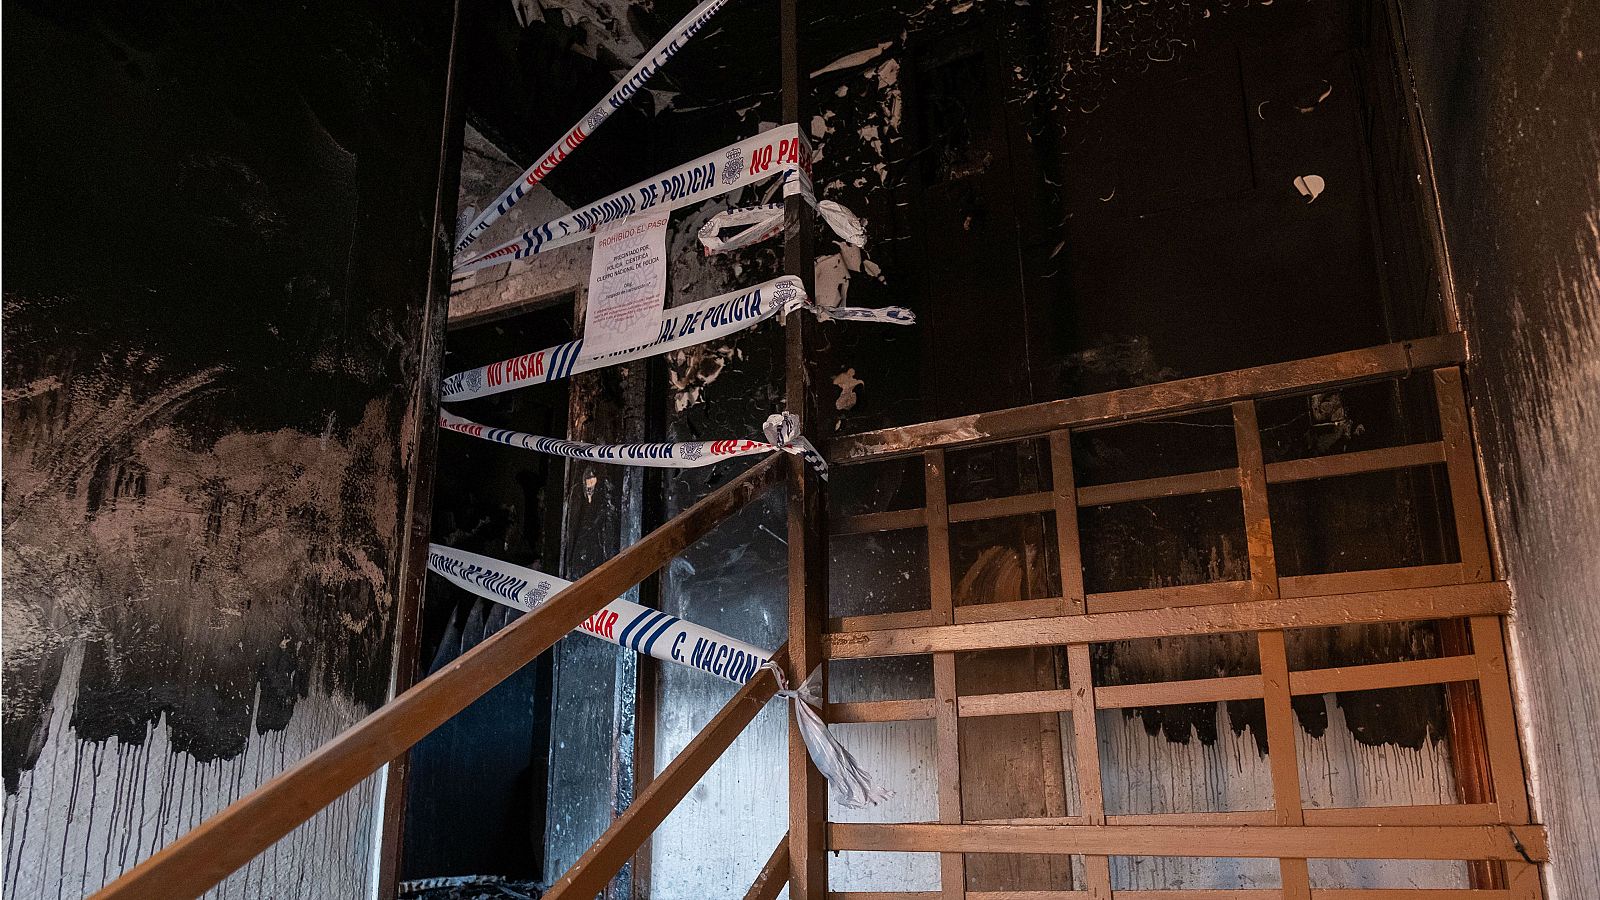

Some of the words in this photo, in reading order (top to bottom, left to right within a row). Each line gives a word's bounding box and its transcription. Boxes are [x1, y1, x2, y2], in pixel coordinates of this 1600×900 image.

[572, 193, 636, 233] NACIONAL
[640, 184, 659, 211] DE
[661, 162, 716, 203] POLICIA
[750, 144, 773, 175] NO
[598, 228, 635, 248] PROHIBIDO
[636, 224, 646, 234] EL
[647, 218, 668, 231] PASO
[679, 310, 702, 337] DE
[700, 289, 762, 331] POLICIA
[487, 362, 503, 388] NO
[506, 351, 546, 384] PASAR
[476, 569, 528, 603] POLICIA
[670, 631, 687, 663] C.
[690, 637, 770, 684] NACION
